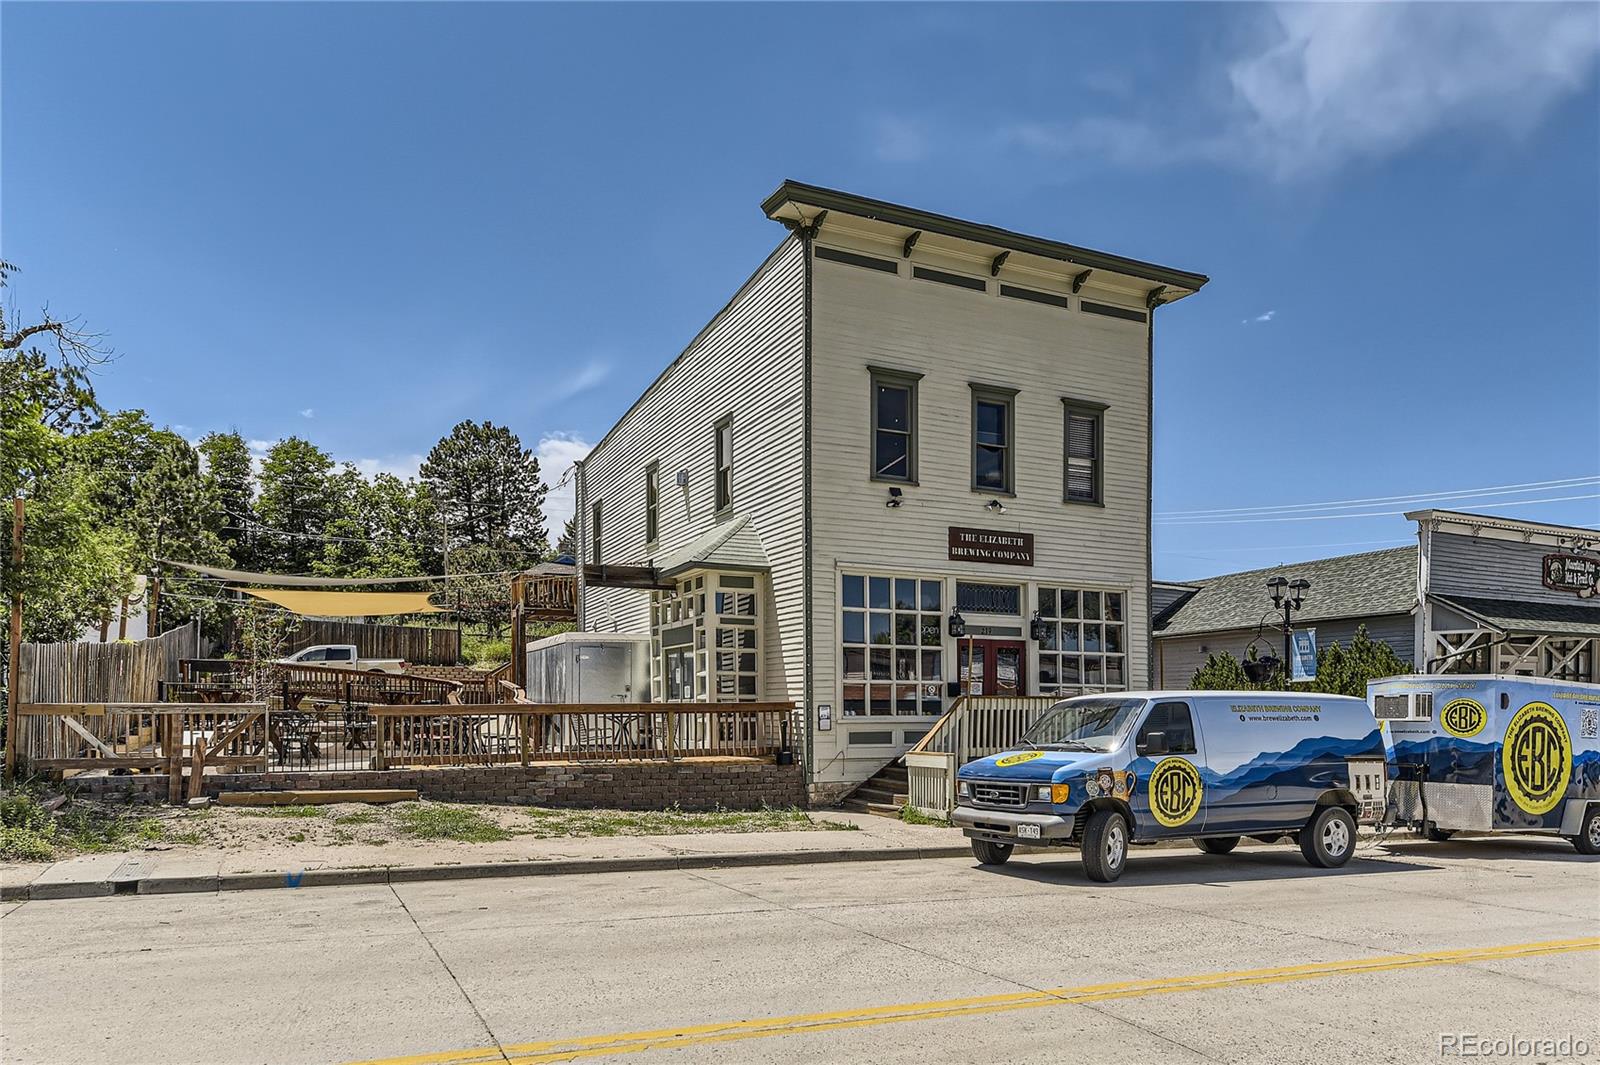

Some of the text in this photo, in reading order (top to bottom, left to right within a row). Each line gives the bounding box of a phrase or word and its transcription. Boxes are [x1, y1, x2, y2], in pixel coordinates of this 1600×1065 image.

[951, 546, 1030, 560] BREWING COMPANY
[960, 533, 1024, 546] THE ELIZABETH
[1449, 706, 1478, 730] EBC
[1507, 706, 1568, 743] THE ELIZABETH BREWING COMPANY
[1518, 726, 1557, 790] EBC
[1160, 772, 1191, 813] EBC
